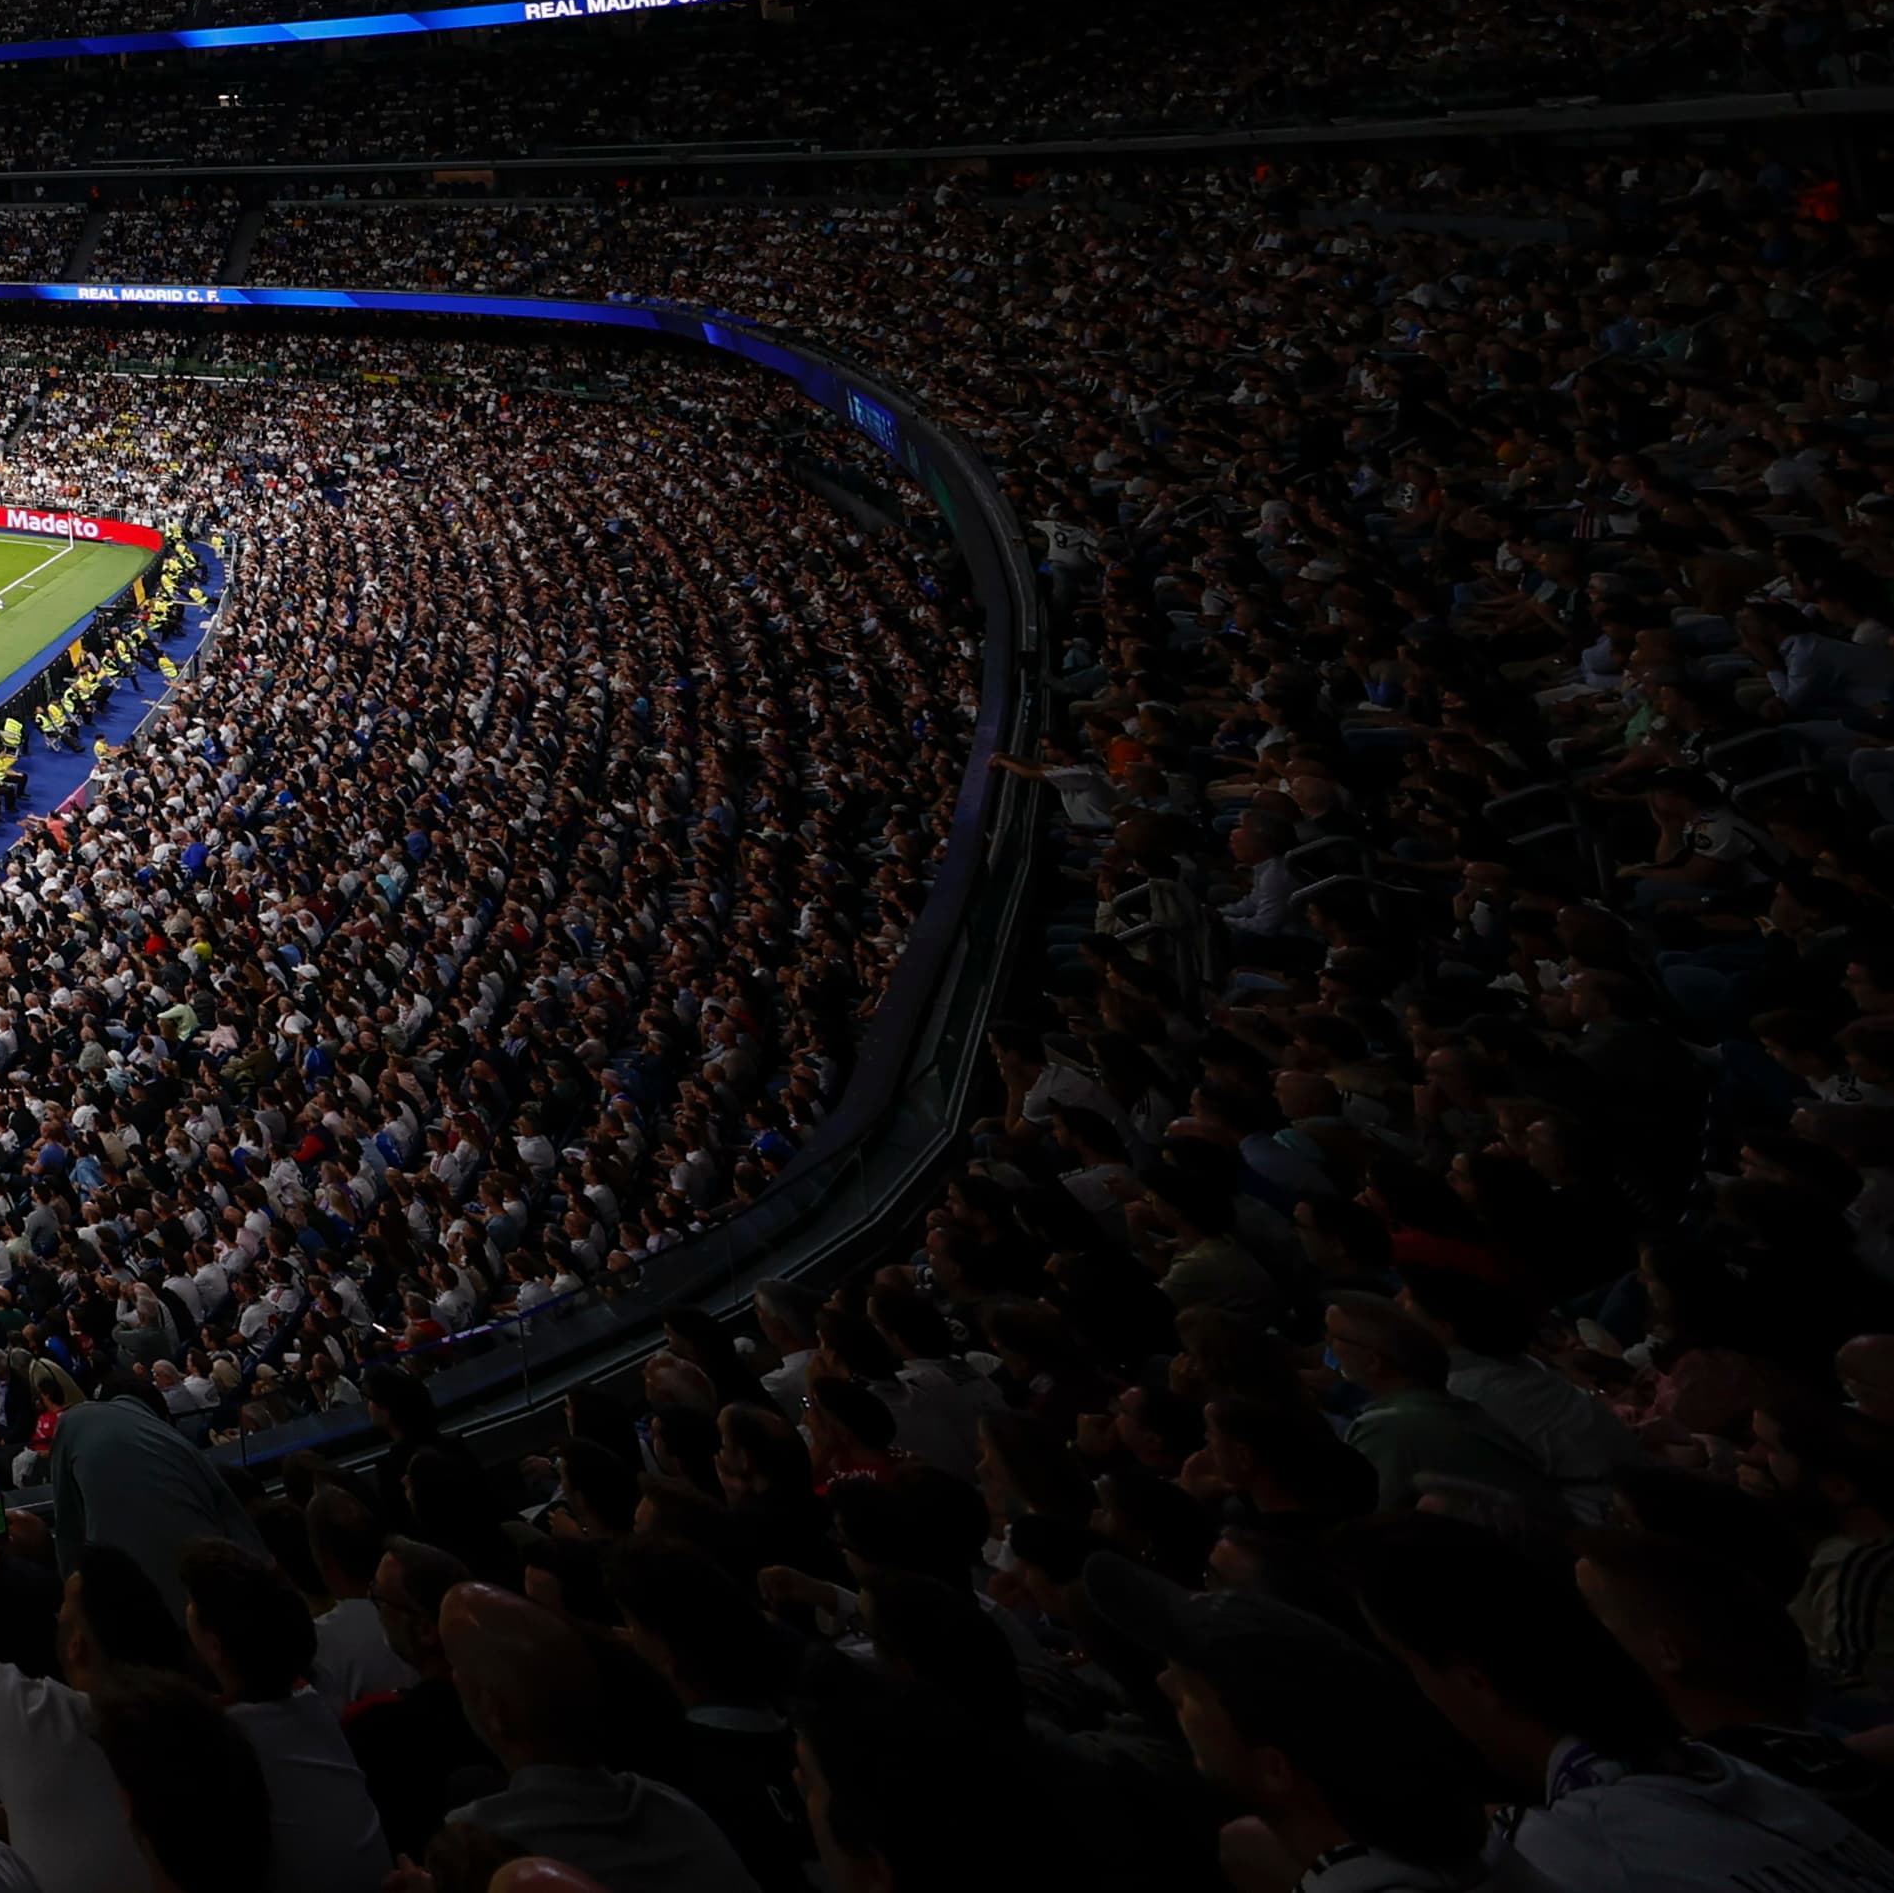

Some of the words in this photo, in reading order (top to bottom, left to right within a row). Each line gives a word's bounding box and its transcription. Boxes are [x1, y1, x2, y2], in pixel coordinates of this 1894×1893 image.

[525, 0, 582, 20] REAL
[78, 287, 117, 300] REAL
[121, 289, 182, 302] MADRID
[7, 509, 69, 533] Made
[72, 515, 98, 538] to
